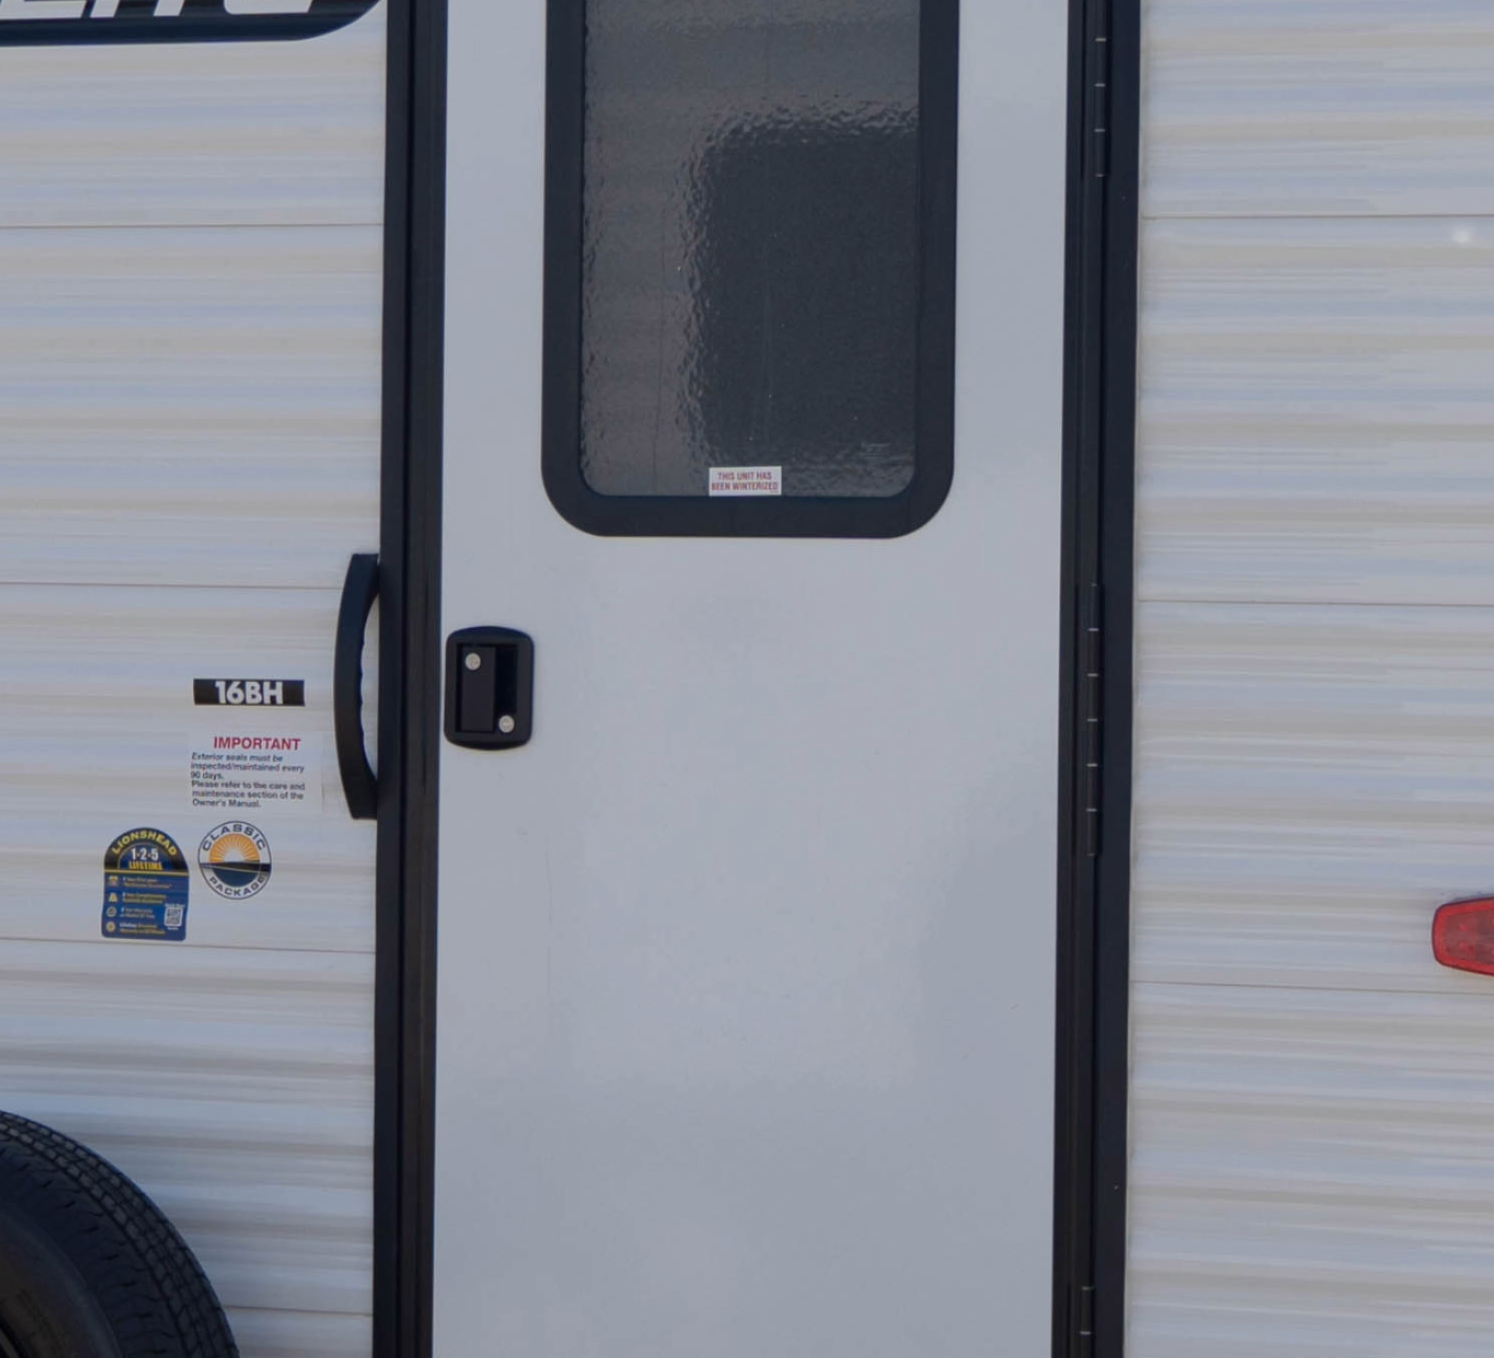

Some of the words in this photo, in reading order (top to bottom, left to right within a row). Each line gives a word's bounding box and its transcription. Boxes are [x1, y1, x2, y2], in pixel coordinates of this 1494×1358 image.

[717, 471, 734, 481] THIS
[737, 471, 754, 481] UNIT
[756, 471, 772, 480] HAS
[711, 482, 730, 491] BEEN
[732, 481, 779, 491] WINTERIZED
[214, 680, 284, 704] 16BH
[212, 736, 302, 751] IMPORTANT
[191, 752, 224, 761] Exterior
[226, 754, 248, 762] seals
[249, 754, 271, 762] must
[272, 754, 283, 762] be
[281, 765, 305, 774] every
[202, 771, 223, 781] days.
[191, 780, 219, 788] Please
[221, 781, 240, 789] refer
[253, 782, 267, 790] the
[289, 783, 306, 791] and
[192, 790, 245, 798] maintenance
[247, 791, 278, 800] section
[279, 791, 289, 800] of
[290, 791, 304, 800] the
[192, 798, 227, 807] Owner's
[228, 799, 261, 808] Manual.
[202, 823, 266, 851] CLASSIC
[111, 830, 178, 856] LIONSHEAD
[209, 872, 268, 897] PACKAGE
